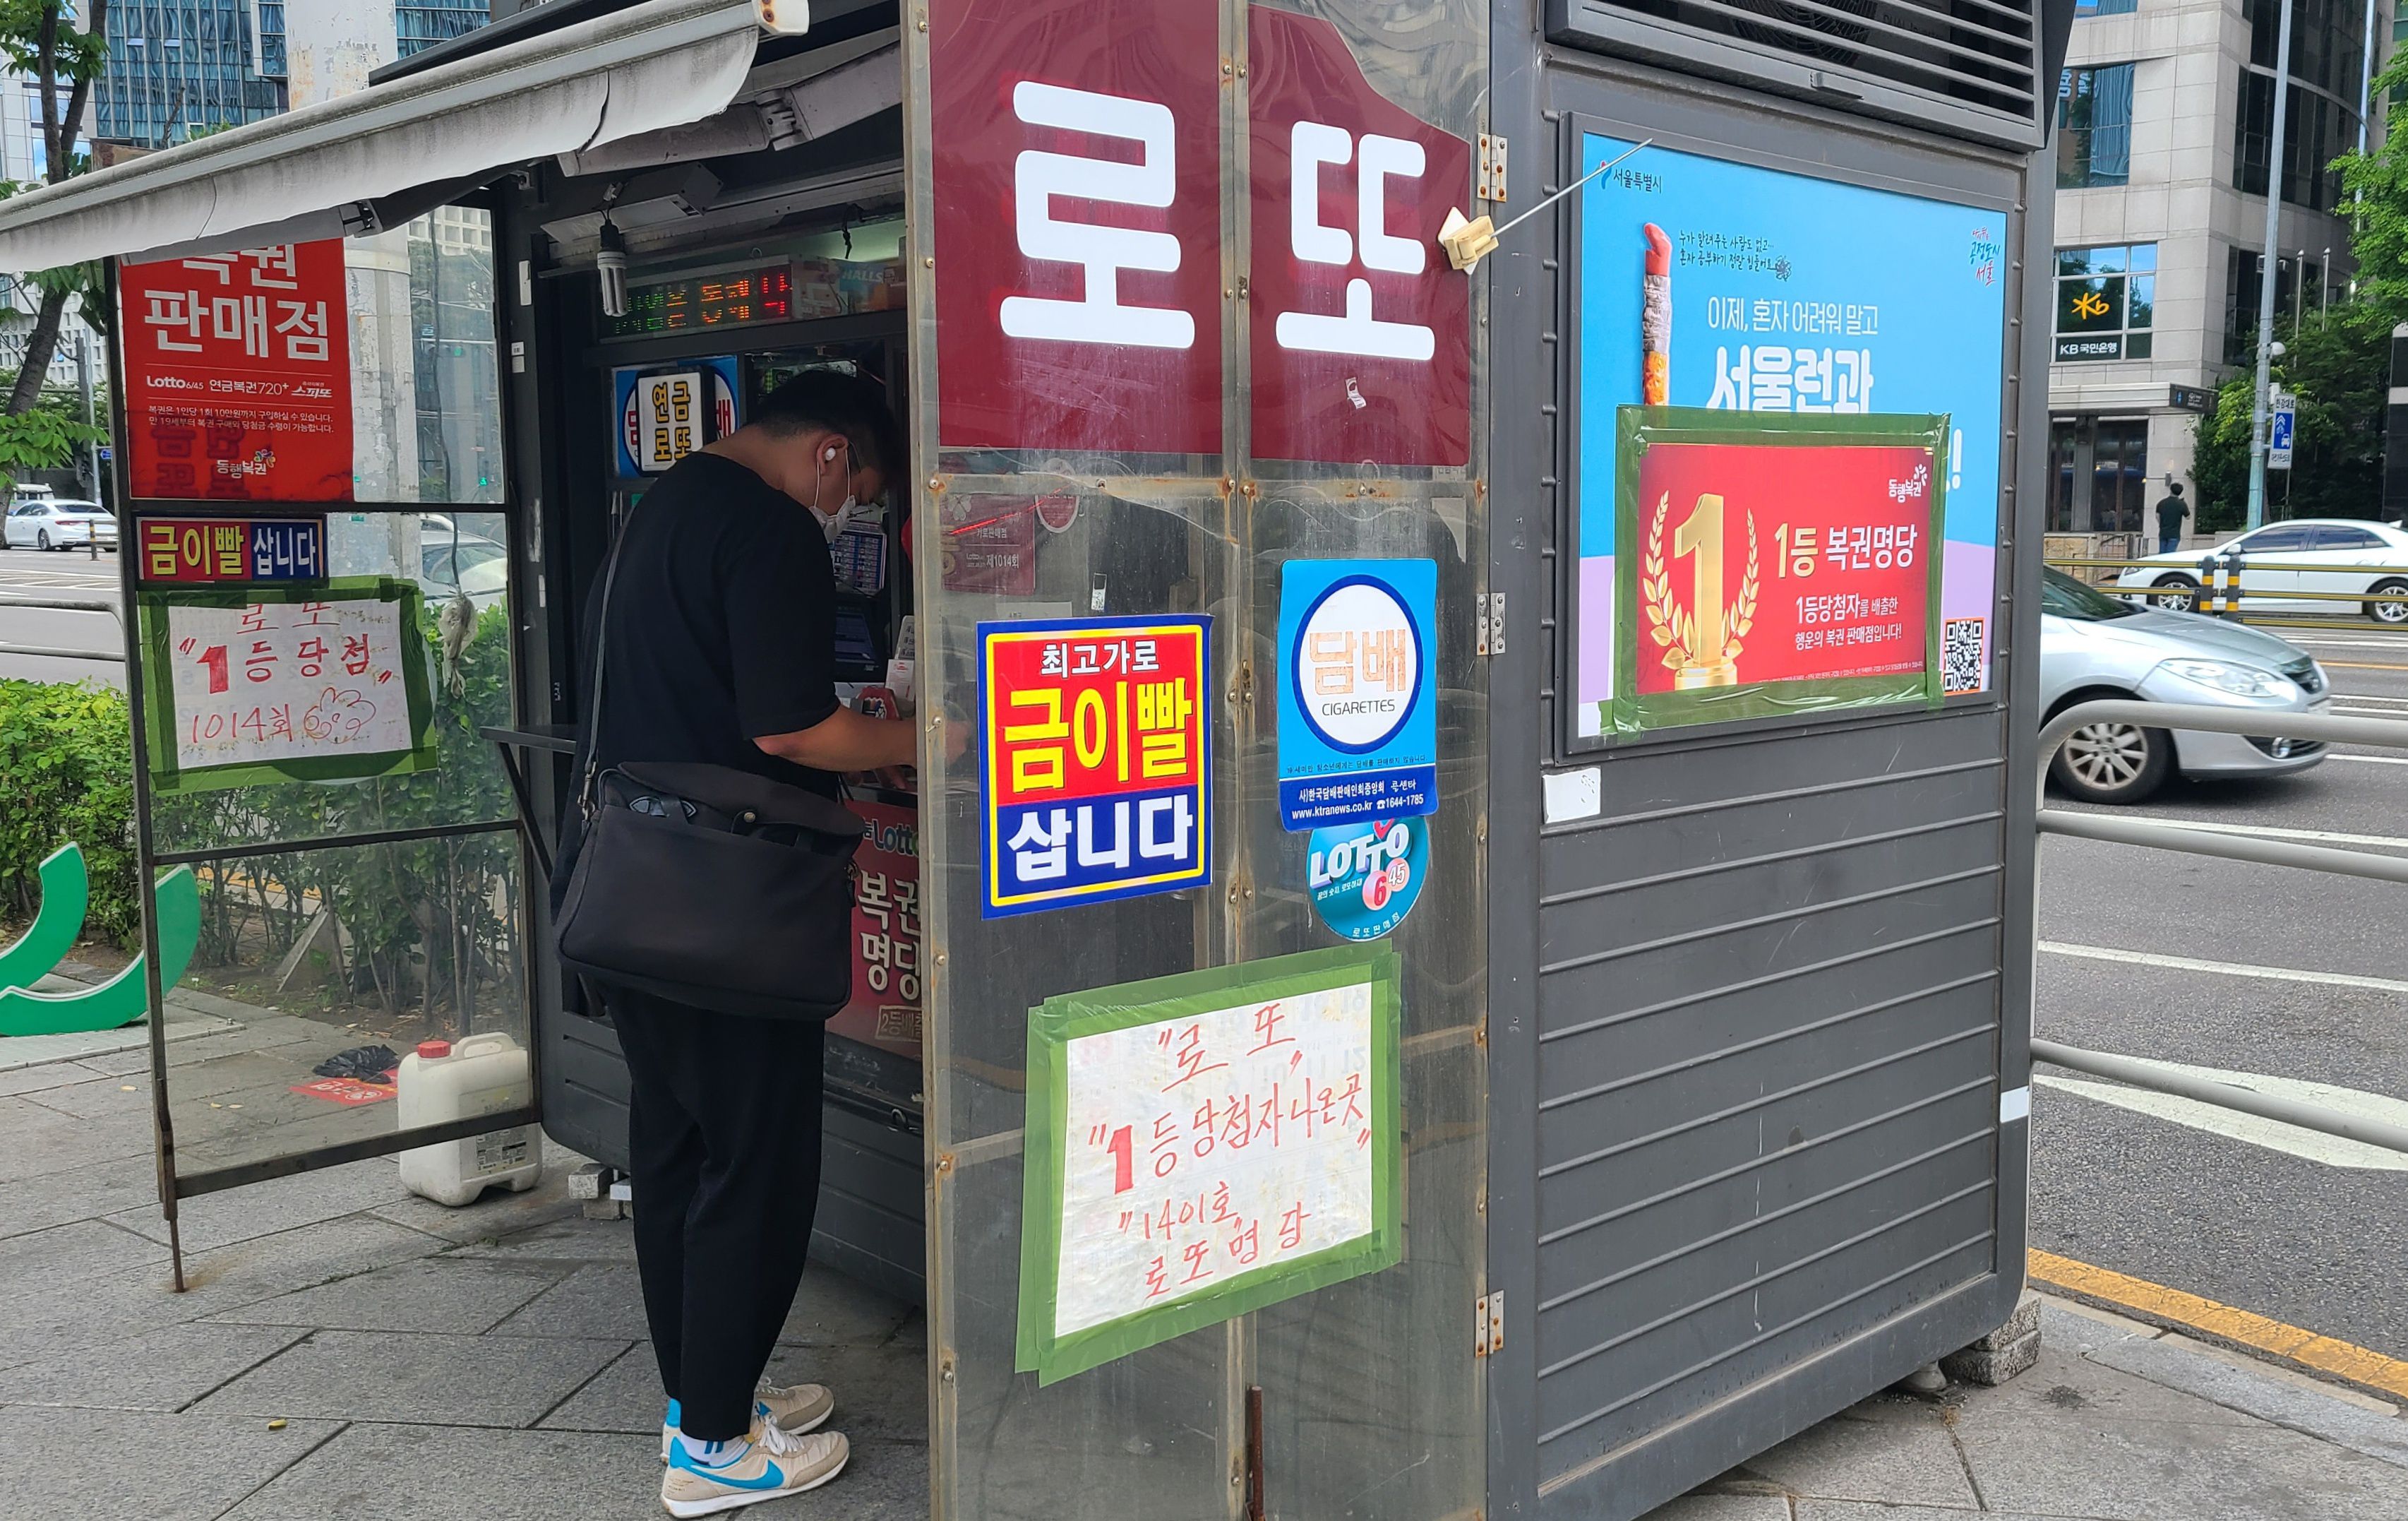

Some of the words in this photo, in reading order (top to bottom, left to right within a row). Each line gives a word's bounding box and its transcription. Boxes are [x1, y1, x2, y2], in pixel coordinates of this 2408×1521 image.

[1613, 169, 1663, 194] 서울특별시
[1679, 229, 1695, 246] 누가
[1698, 230, 1727, 249] 알려주는
[1730, 234, 1752, 251] 사람도
[1680, 248, 1696, 266] 혼자
[1698, 250, 1727, 267] 공부하기
[1730, 253, 1745, 270] 정말
[145, 290, 329, 362] 판매점
[1708, 297, 1749, 333] 이제,
[1752, 299, 1790, 333] 혼자
[1792, 302, 1841, 335] 어려워
[1847, 304, 1879, 335] 말고
[2060, 342, 2118, 355] KB국민은행
[291, 385, 333, 399] 스피또
[1706, 345, 1874, 413] 서울런과
[148, 405, 174, 415] 복권은
[176, 407, 198, 416] 1인당
[200, 407, 213, 417] 1회
[258, 410, 289, 421] 구입하실
[291, 412, 299, 421] 수
[300, 412, 334, 423] 있습니다.
[652, 381, 691, 424] 연금
[149, 416, 157, 426] 만
[198, 418, 215, 428] 복권
[654, 427, 691, 463] 로또
[216, 459, 268, 479] 동행복권
[1888, 479, 1922, 503] 동행복권
[148, 525, 244, 575] 금이빨
[253, 527, 316, 576] 삽니다
[1774, 523, 1819, 579] 1등
[1826, 524, 1918, 571] 복권명당
[1796, 592, 1869, 625] 1등당첨자를
[1871, 596, 1899, 616] 배출한
[1795, 629, 1823, 651] 행운의
[1826, 627, 1845, 647] 복권
[1847, 623, 1903, 645] 판매점입니다!
[1041, 639, 1160, 679] 최고가로
[1310, 628, 1406, 696] 담배
[192, 703, 294, 744] 1014회
[1322, 698, 1396, 716] CIGARETTES
[1004, 676, 1194, 794] 금이빨
[1292, 800, 1373, 820] www.ktranews.co.kr
[1386, 793, 1424, 808] 1644-1785
[1007, 794, 1193, 883] 삽니다
[1310, 823, 1410, 889] LOTTO
[1374, 876, 1387, 907] 6
[1388, 863, 1406, 887] 45
[860, 932, 921, 1001] 명당
